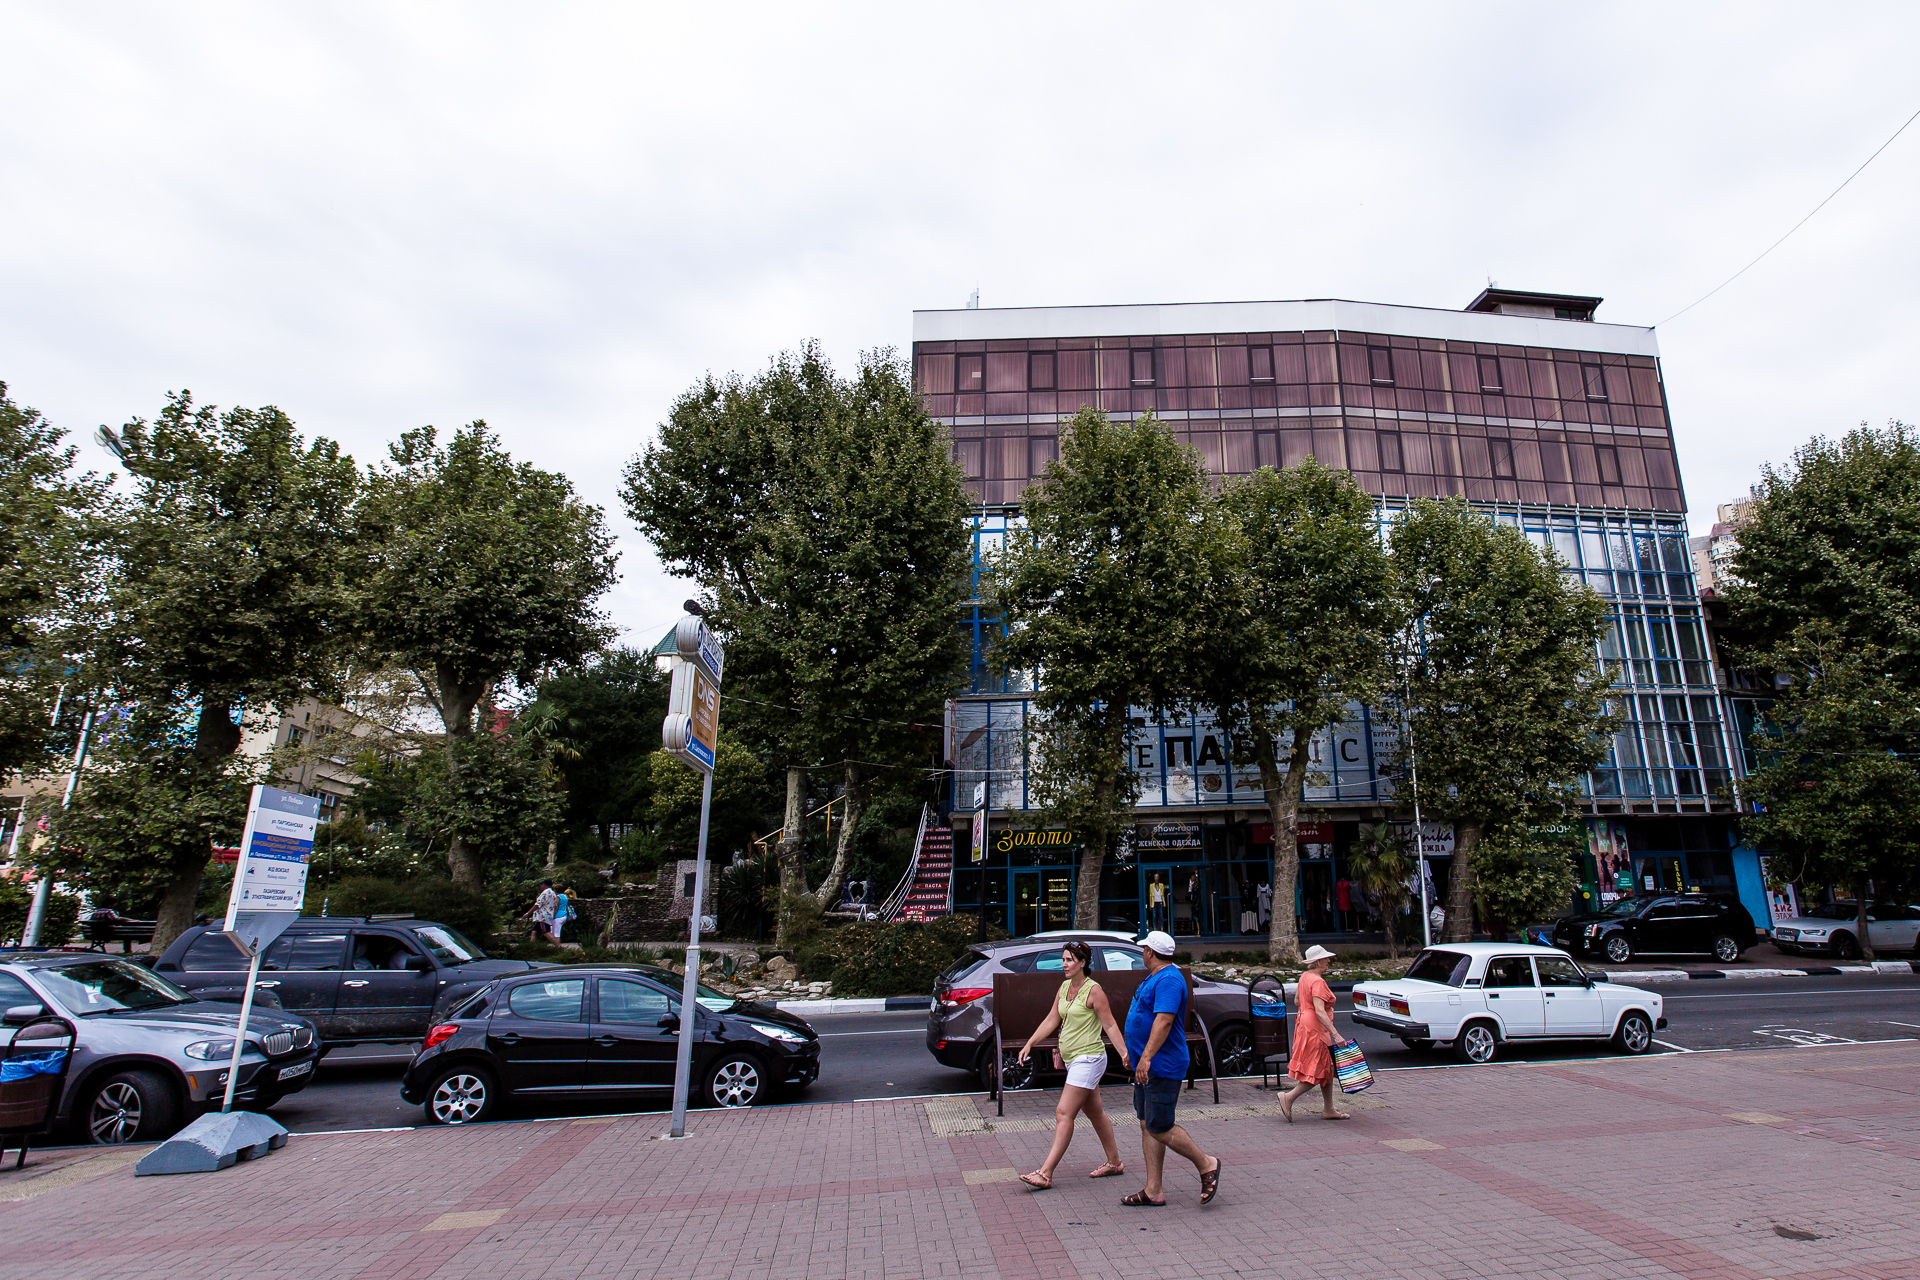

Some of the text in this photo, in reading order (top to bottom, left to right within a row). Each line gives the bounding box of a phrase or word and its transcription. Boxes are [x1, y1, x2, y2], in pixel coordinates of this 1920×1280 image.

[697, 676, 715, 711] DNS
[1153, 825, 1199, 833] show-room
[997, 828, 1072, 852] Золото
[1172, 839, 1201, 847] ОДЕЖДА
